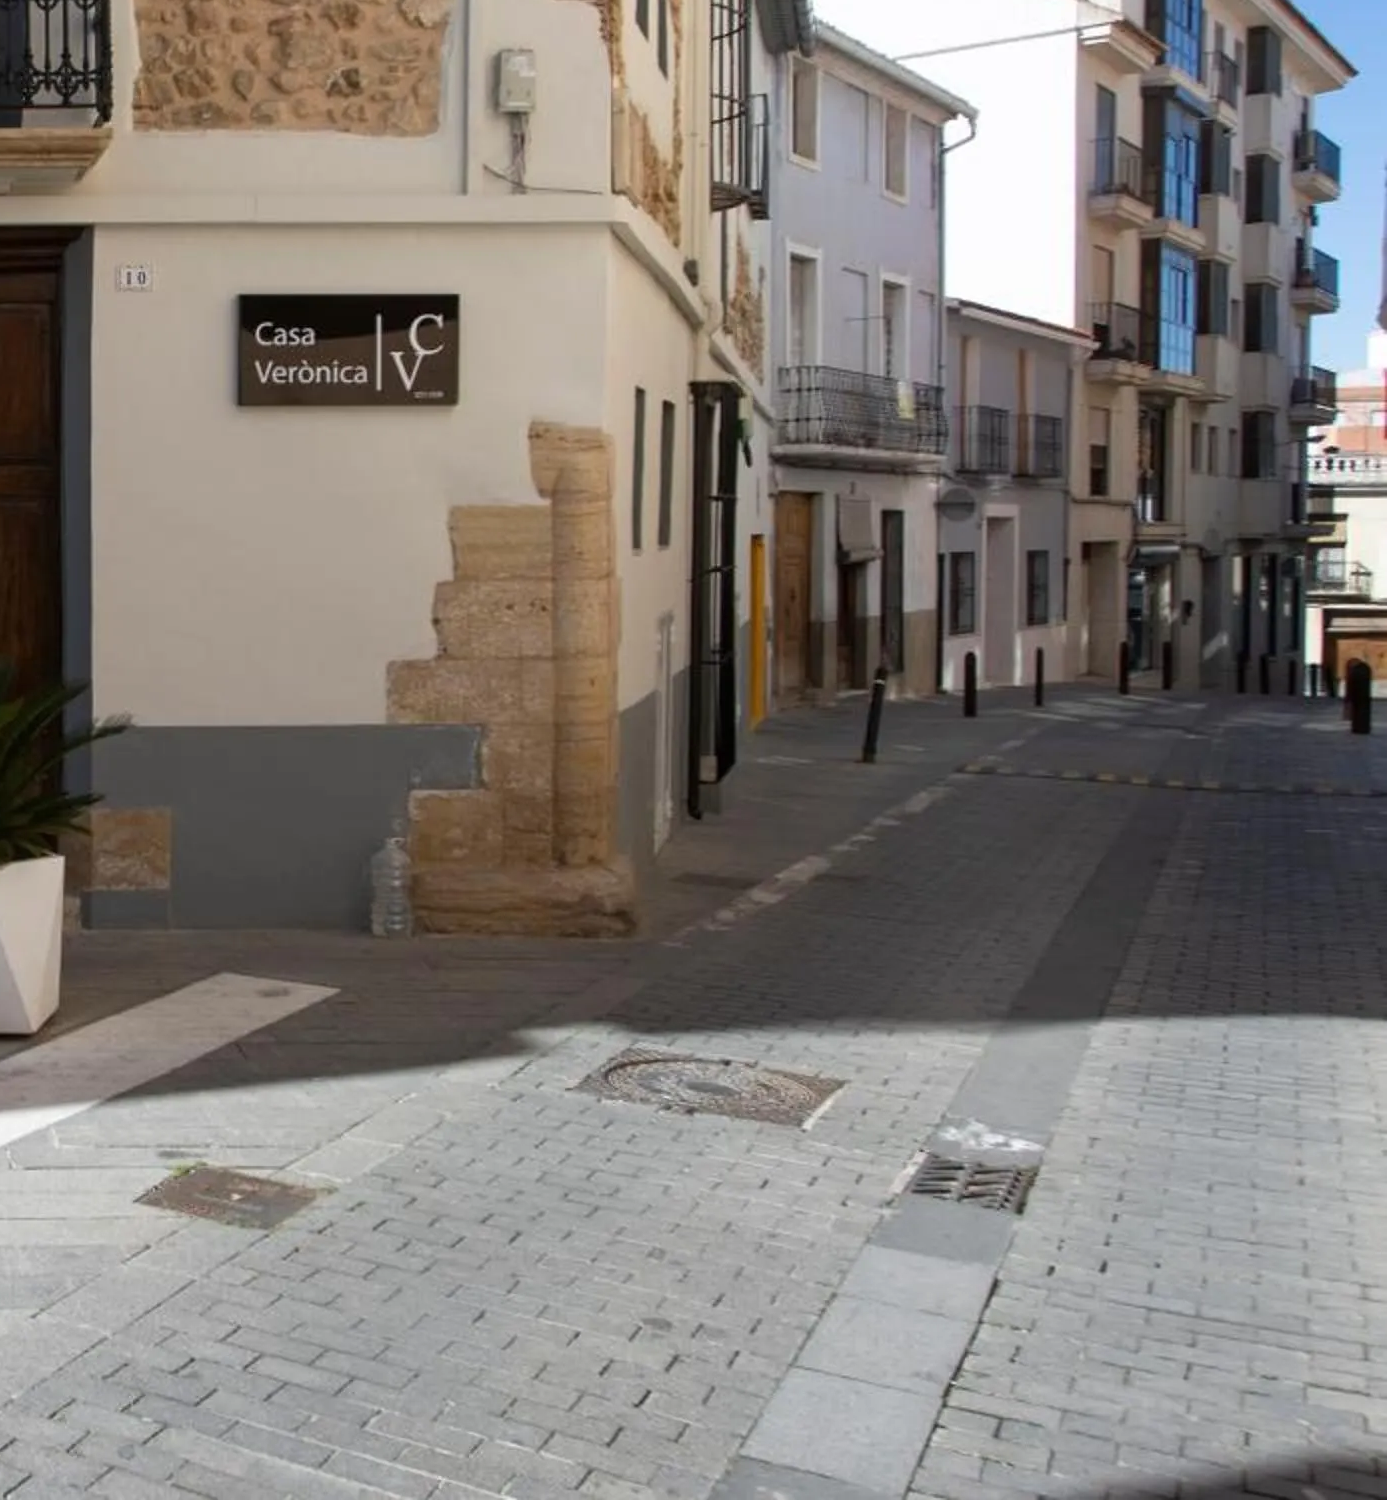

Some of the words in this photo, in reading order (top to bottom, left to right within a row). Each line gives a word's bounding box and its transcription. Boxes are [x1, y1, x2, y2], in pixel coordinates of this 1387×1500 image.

[125, 271, 146, 285] 10
[254, 322, 316, 347] Casa
[254, 360, 369, 385] Verònica
